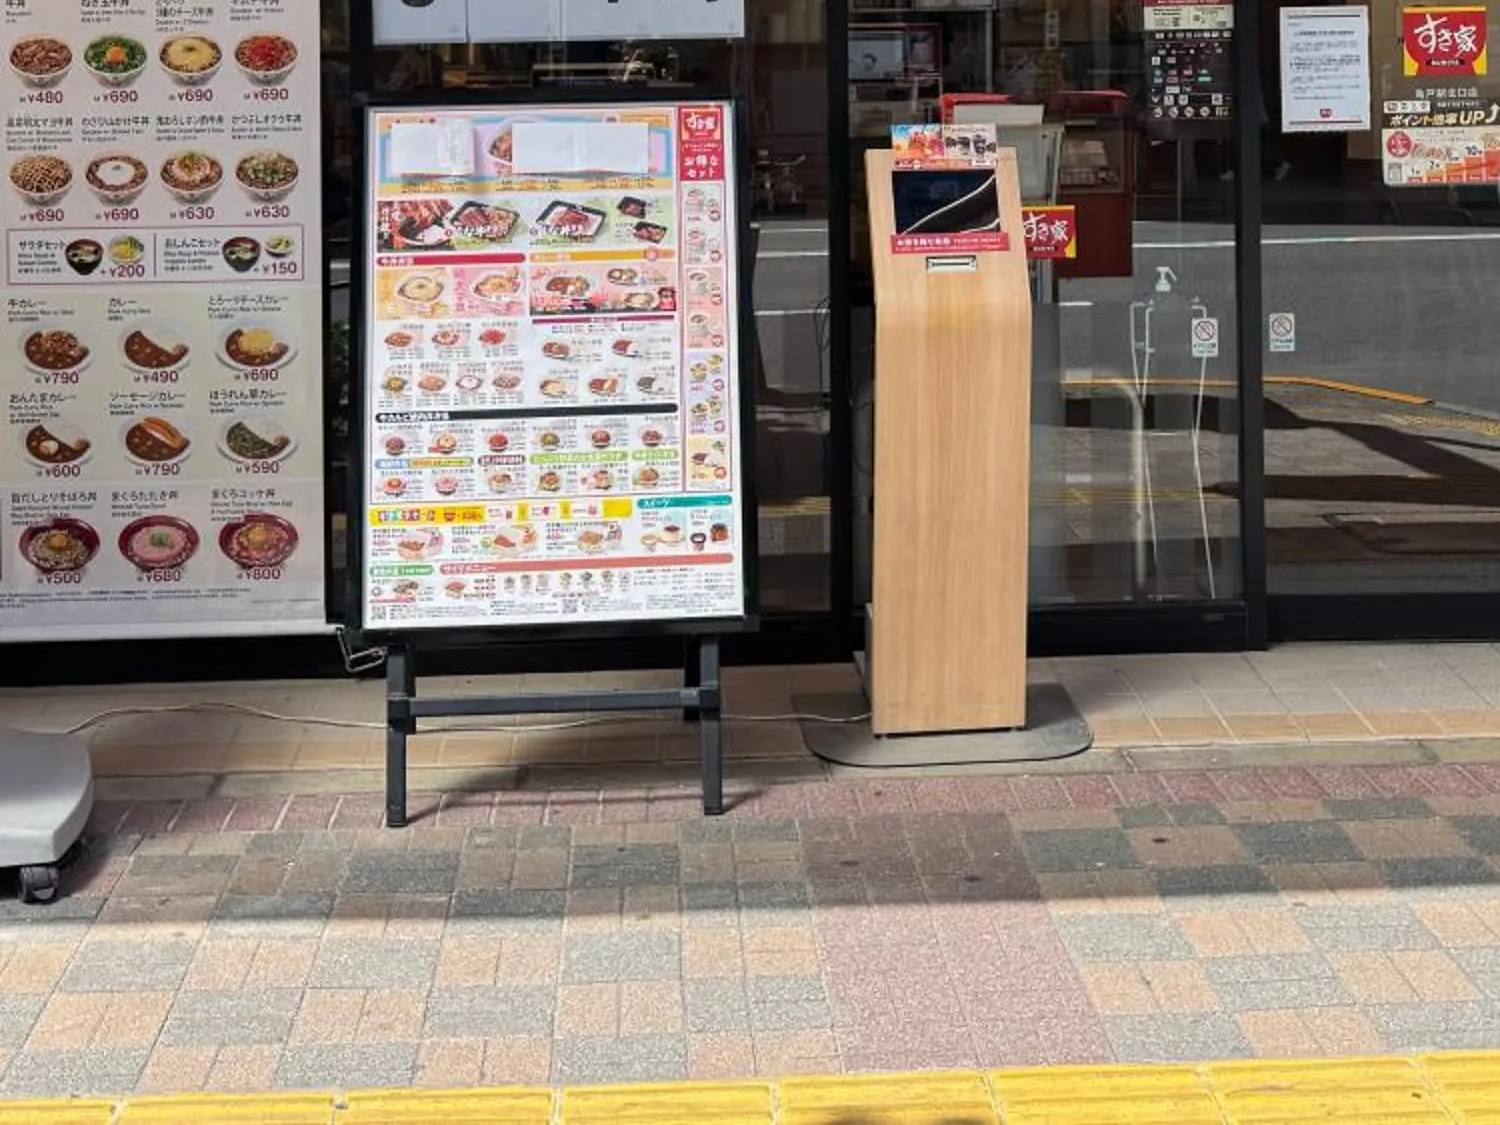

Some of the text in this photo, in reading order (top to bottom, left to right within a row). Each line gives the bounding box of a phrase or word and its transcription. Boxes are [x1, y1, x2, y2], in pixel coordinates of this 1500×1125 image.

[1414, 13, 1477, 58] すき家
[1024, 213, 1069, 244] すき家
